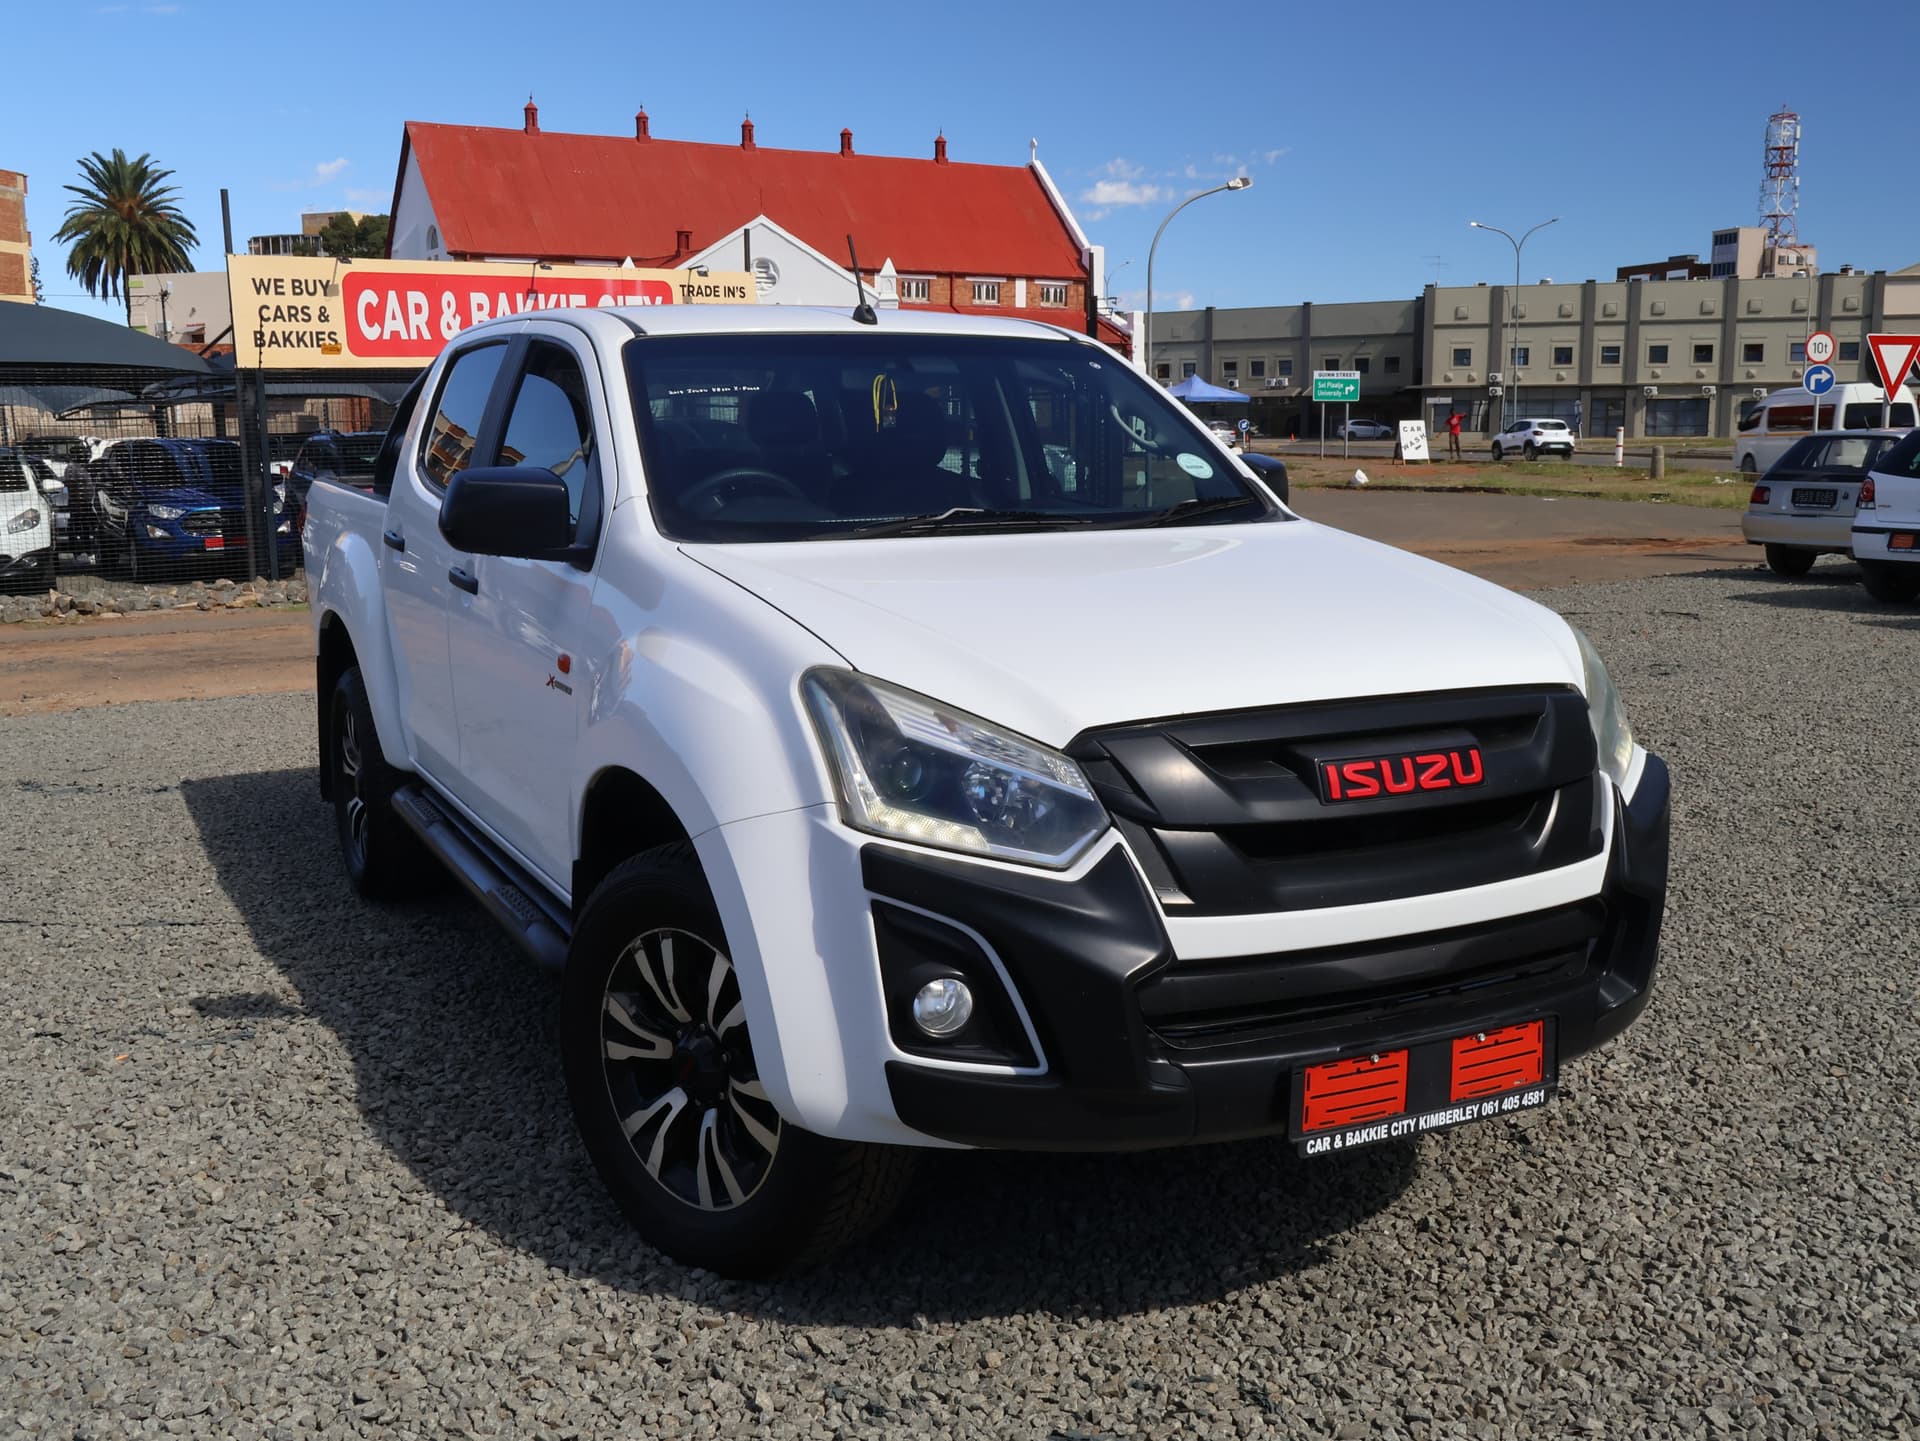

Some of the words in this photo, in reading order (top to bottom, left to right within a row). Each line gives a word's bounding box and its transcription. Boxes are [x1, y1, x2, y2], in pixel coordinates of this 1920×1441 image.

[251, 277, 286, 296] WE
[291, 278, 331, 297] BUY
[680, 284, 720, 298] TRADE
[723, 285, 746, 299] IN'S
[258, 304, 312, 323] CARS
[318, 305, 330, 323] &
[356, 288, 432, 341] CAR
[440, 290, 462, 341] &
[253, 330, 338, 348] BAKKIES
[1813, 342, 1828, 354] 10t
[1317, 389, 1342, 398] University
[1402, 433, 1426, 450] WASH
[1325, 749, 1484, 801] ISUZU
[1306, 1136, 1331, 1154] CAR
[1333, 1134, 1342, 1149] &
[1345, 1124, 1388, 1147] BAKKIE
[1390, 1117, 1417, 1137] CITY
[1419, 1104, 1480, 1130] KIMBERLEY
[1481, 1099, 1499, 1117] 061
[1501, 1095, 1520, 1112] 405
[1521, 1089, 1545, 1107] 4581
